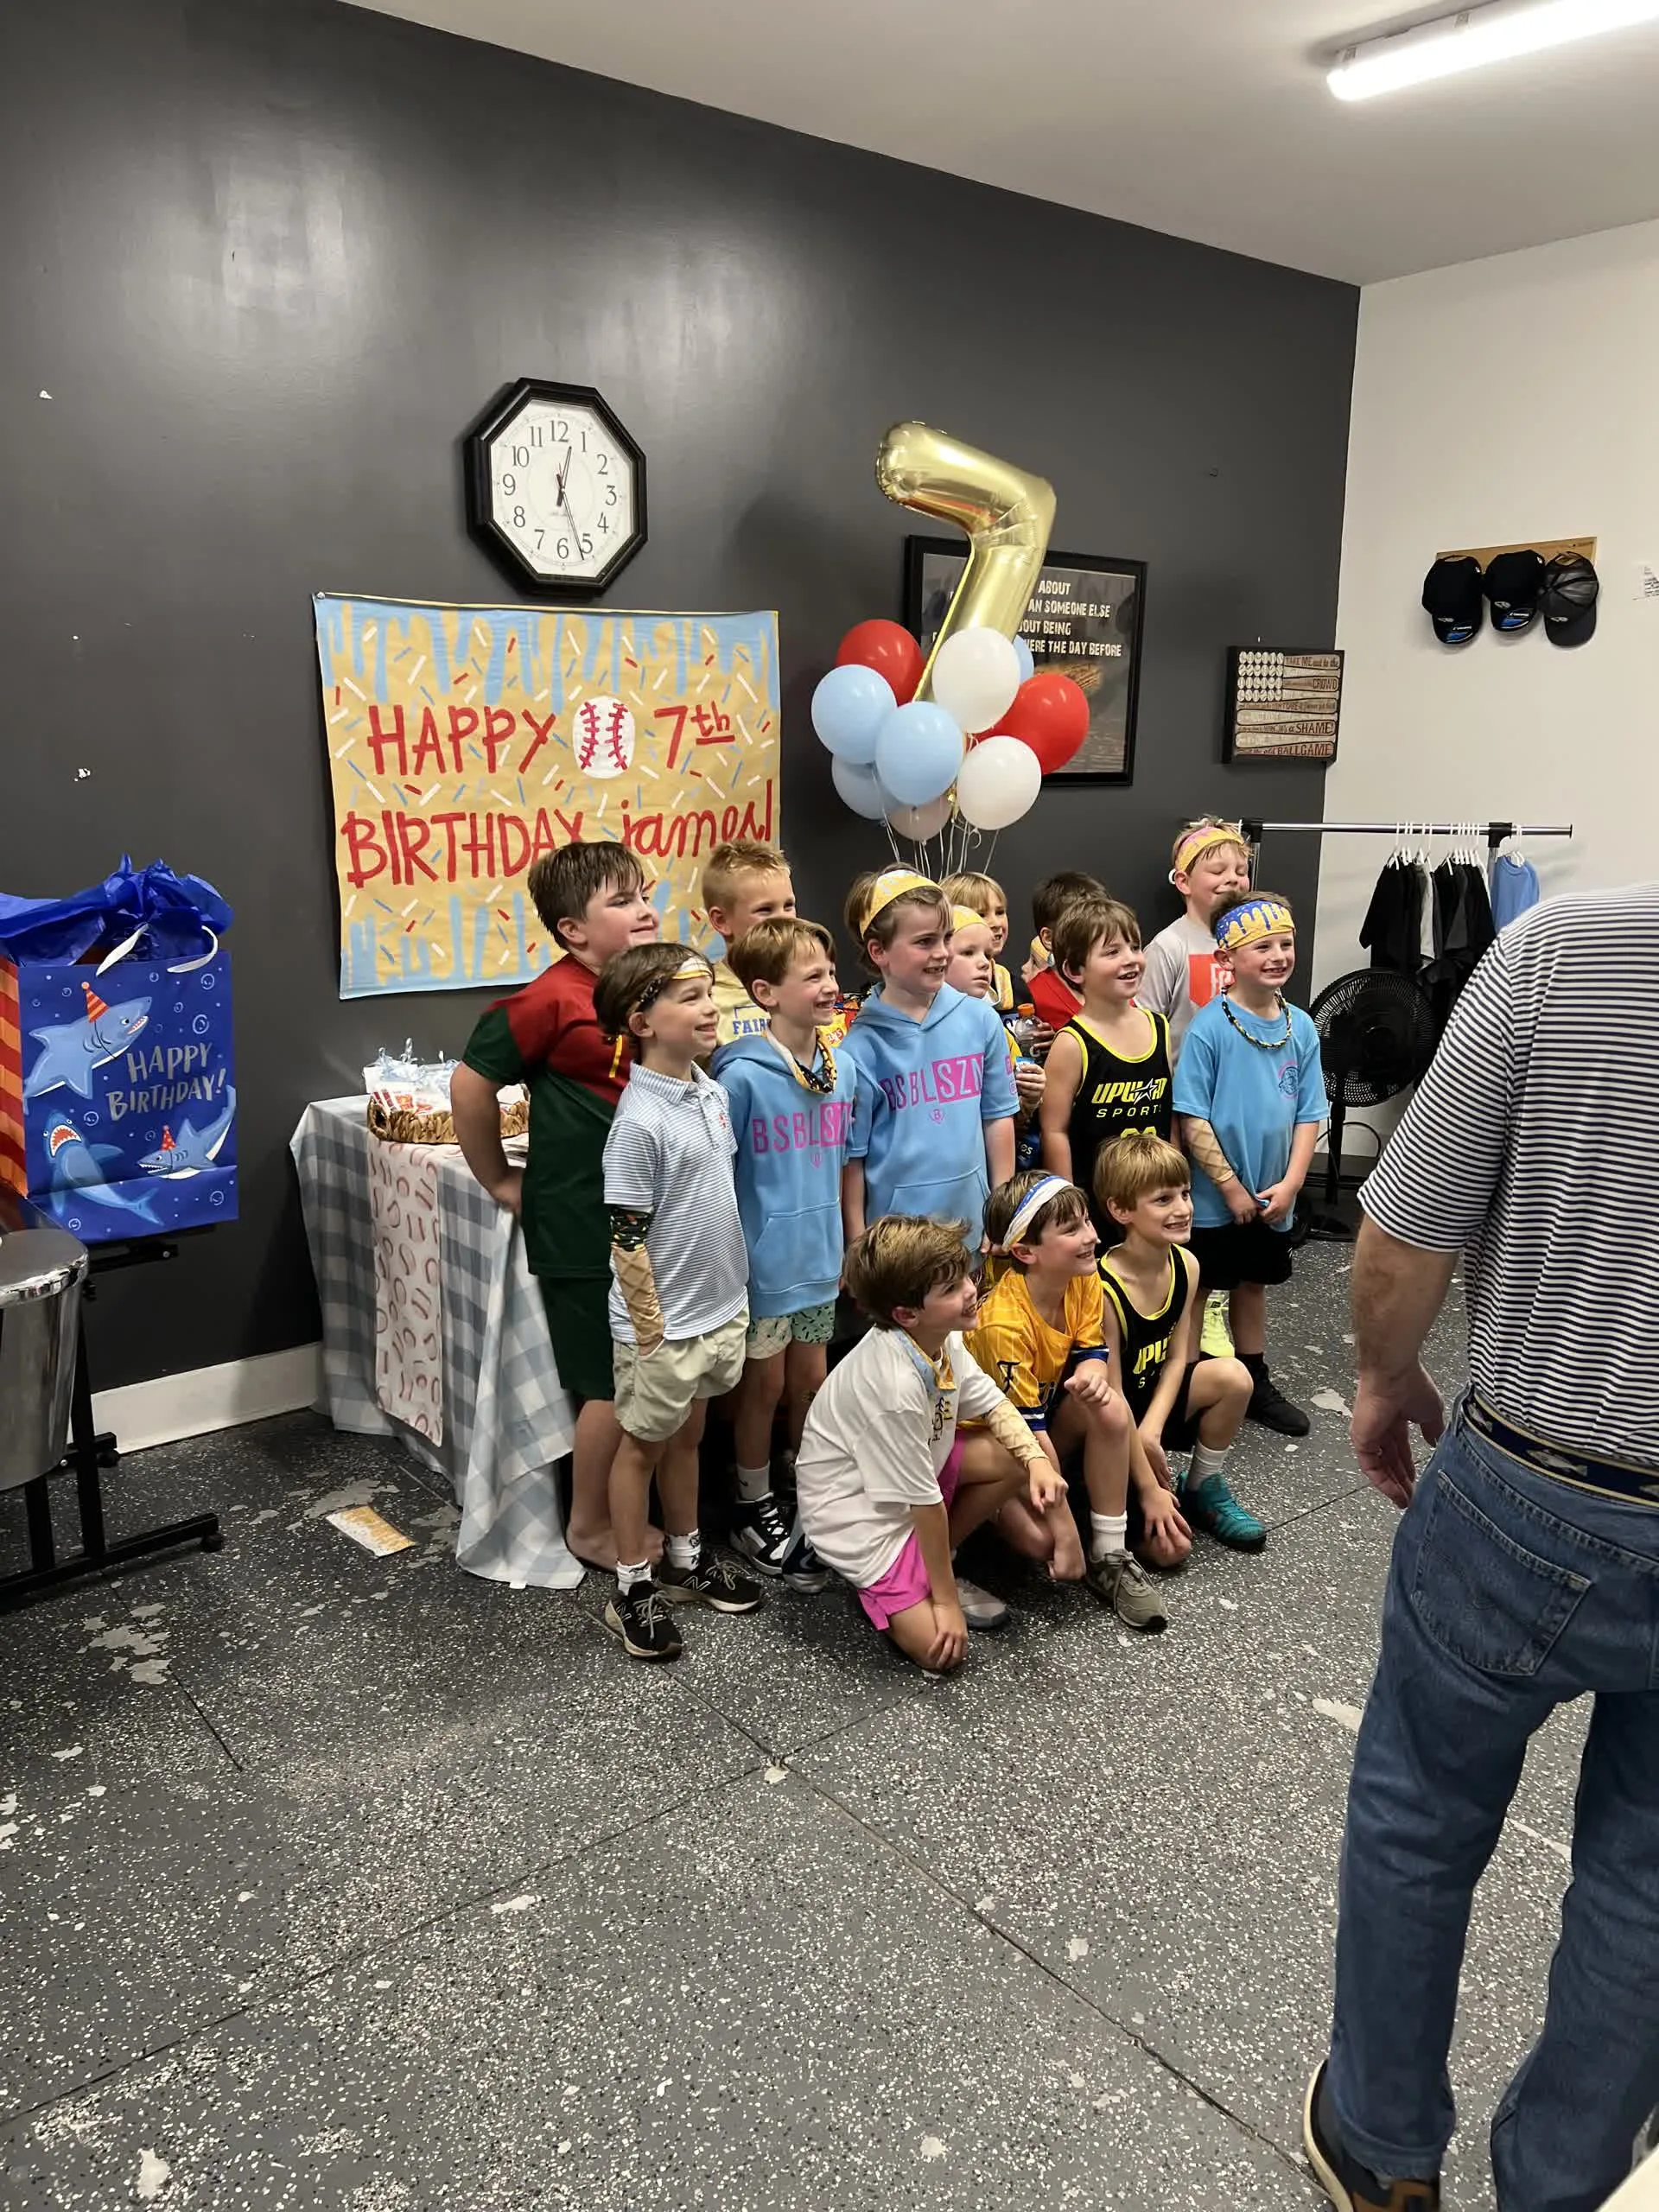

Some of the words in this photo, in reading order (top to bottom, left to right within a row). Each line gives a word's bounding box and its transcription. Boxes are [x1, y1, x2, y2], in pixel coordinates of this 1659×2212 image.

[530, 426, 543, 448] 11
[550, 420, 569, 442] 12
[581, 431, 587, 452] 1
[512, 446, 530, 467] 10
[596, 454, 608, 475] 2
[502, 474, 516, 496] 9
[605, 485, 617, 505] 3
[513, 505, 526, 527] 8
[596, 512, 609, 533] 4
[533, 529, 545, 550] 7
[556, 537, 569, 559] 6
[581, 533, 594, 554] 5
[1038, 580, 1071, 595] ABOUT
[1027, 599, 1042, 613] AN
[1044, 600, 1087, 616] SOMEONE
[1088, 604, 1110, 618] ELSE
[1018, 619, 1041, 632] OUT
[1043, 621, 1071, 635] BEING
[1048, 640, 1067, 654] THE
[1069, 641, 1087, 655] DAY
[1089, 643, 1122, 657] BEFORE
[367, 705, 557, 775] HAPPY
[654, 700, 735, 769] 7th
[341, 808, 583, 888] BIRTHDAY
[733, 1018, 772, 1035] FAIR
[126, 1042, 213, 1084] HAPPY
[105, 1068, 226, 1122] BIRTHDAY!
